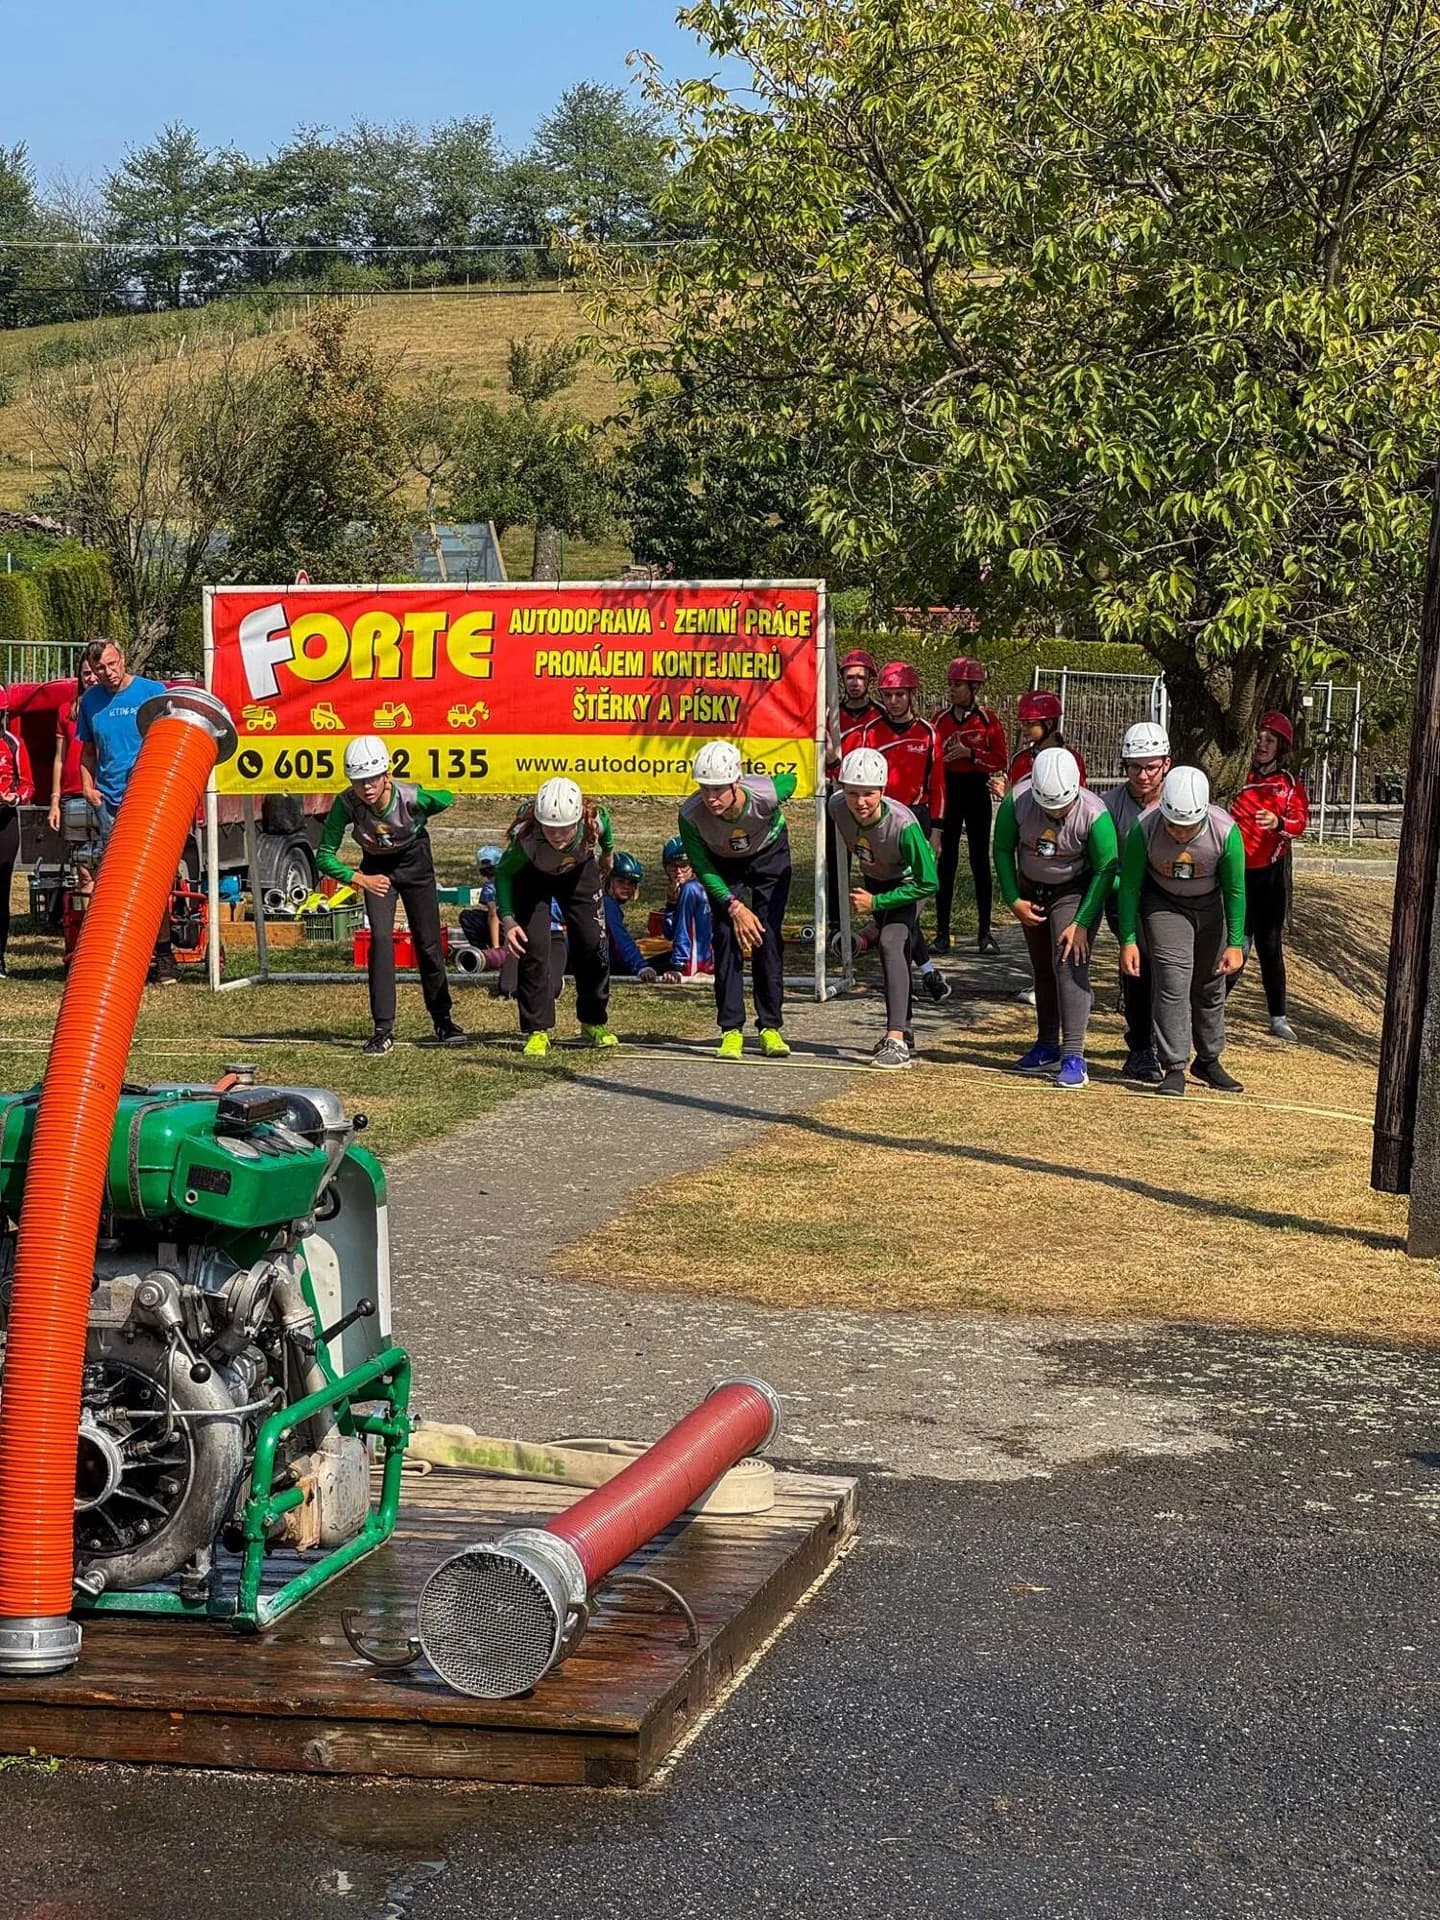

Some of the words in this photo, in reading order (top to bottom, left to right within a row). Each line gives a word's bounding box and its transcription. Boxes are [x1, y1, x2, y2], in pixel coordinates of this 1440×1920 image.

[508, 607, 652, 635] AUTODOPRAVA
[673, 600, 740, 636] ZEMNÍ
[745, 602, 811, 637] PRÁCE
[239, 602, 494, 700] FORTE
[534, 643, 644, 677] PRONÁJEM
[651, 646, 781, 680] KONTEJNERŮ
[572, 686, 651, 721] ŠTĚRKY
[657, 695, 673, 721] A
[679, 687, 740, 722] PÍSKY
[274, 749, 334, 779] 605
[428, 749, 489, 779] 135
